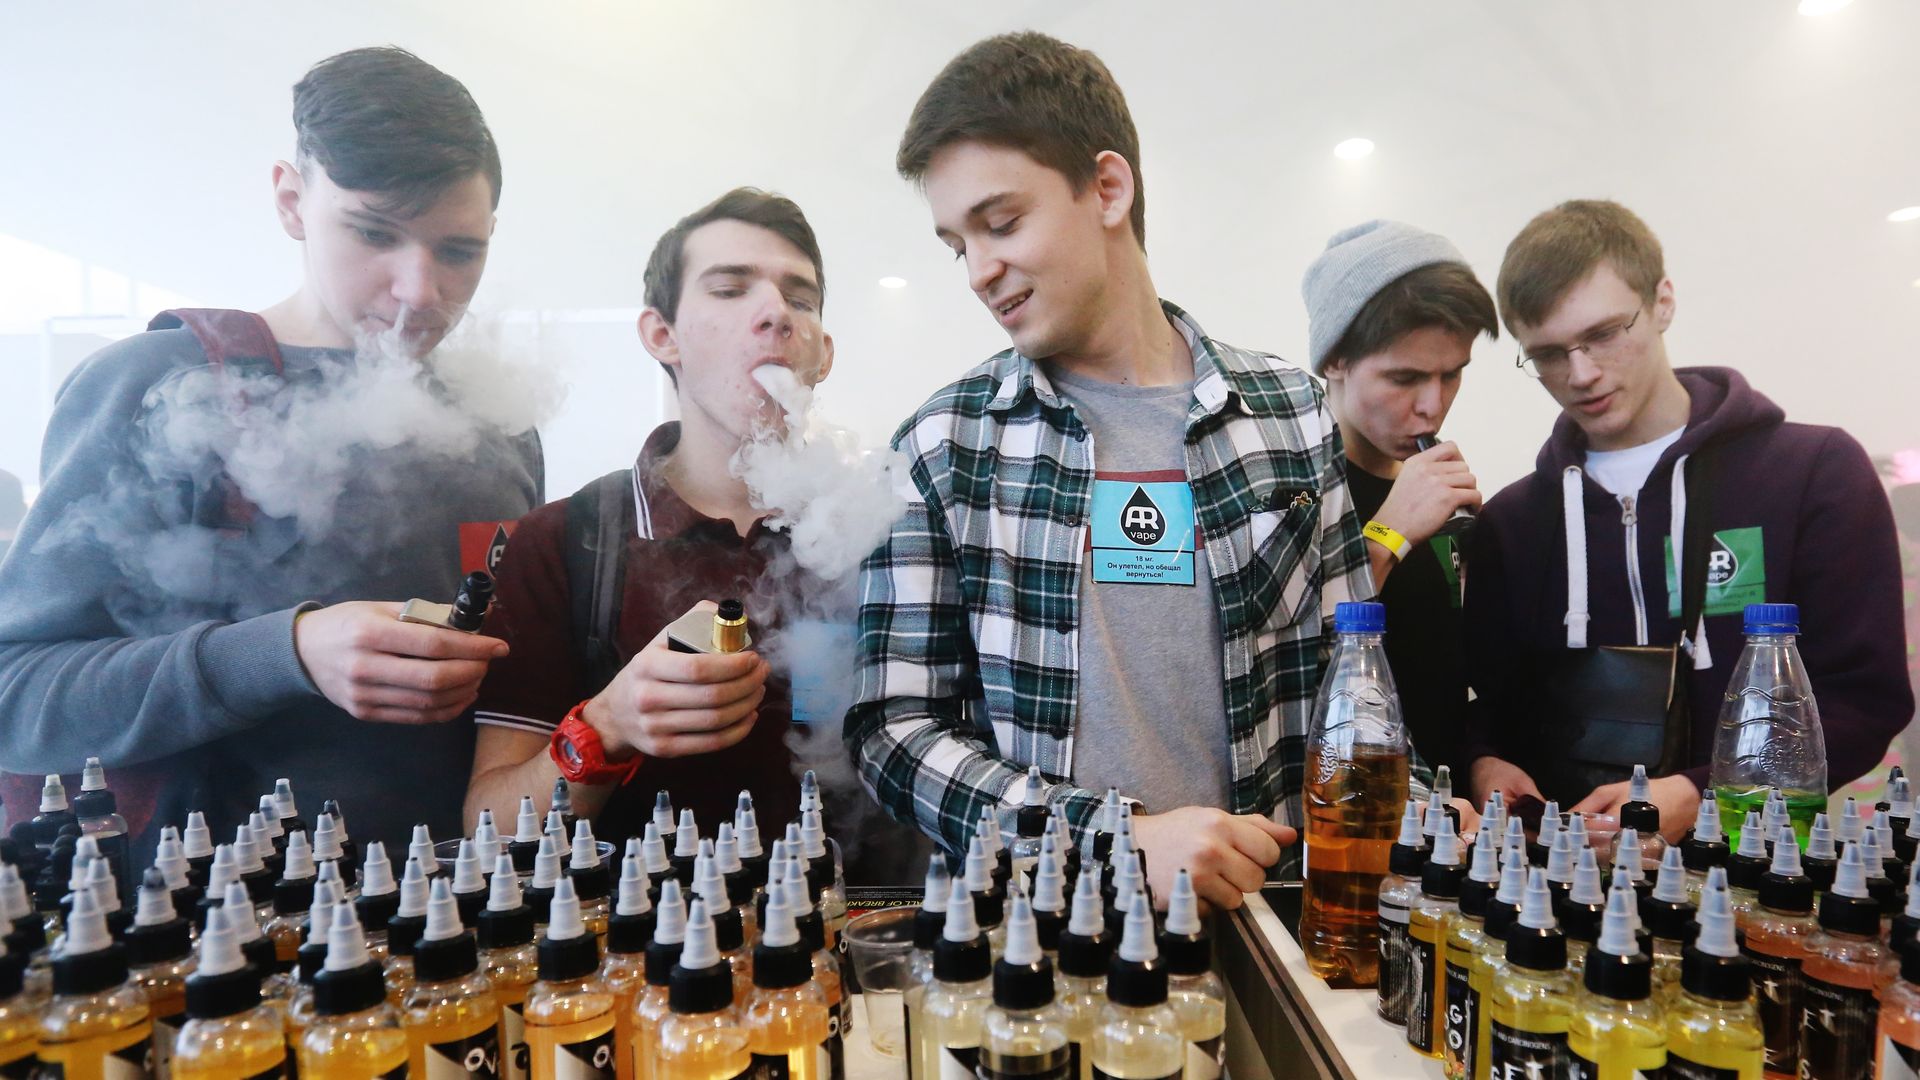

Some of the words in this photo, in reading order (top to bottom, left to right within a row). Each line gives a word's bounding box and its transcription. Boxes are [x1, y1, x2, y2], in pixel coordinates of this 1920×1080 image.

[1130, 531, 1157, 541] vape
[1126, 571, 1164, 579] вернуться!
[1708, 572, 1729, 581] ape
